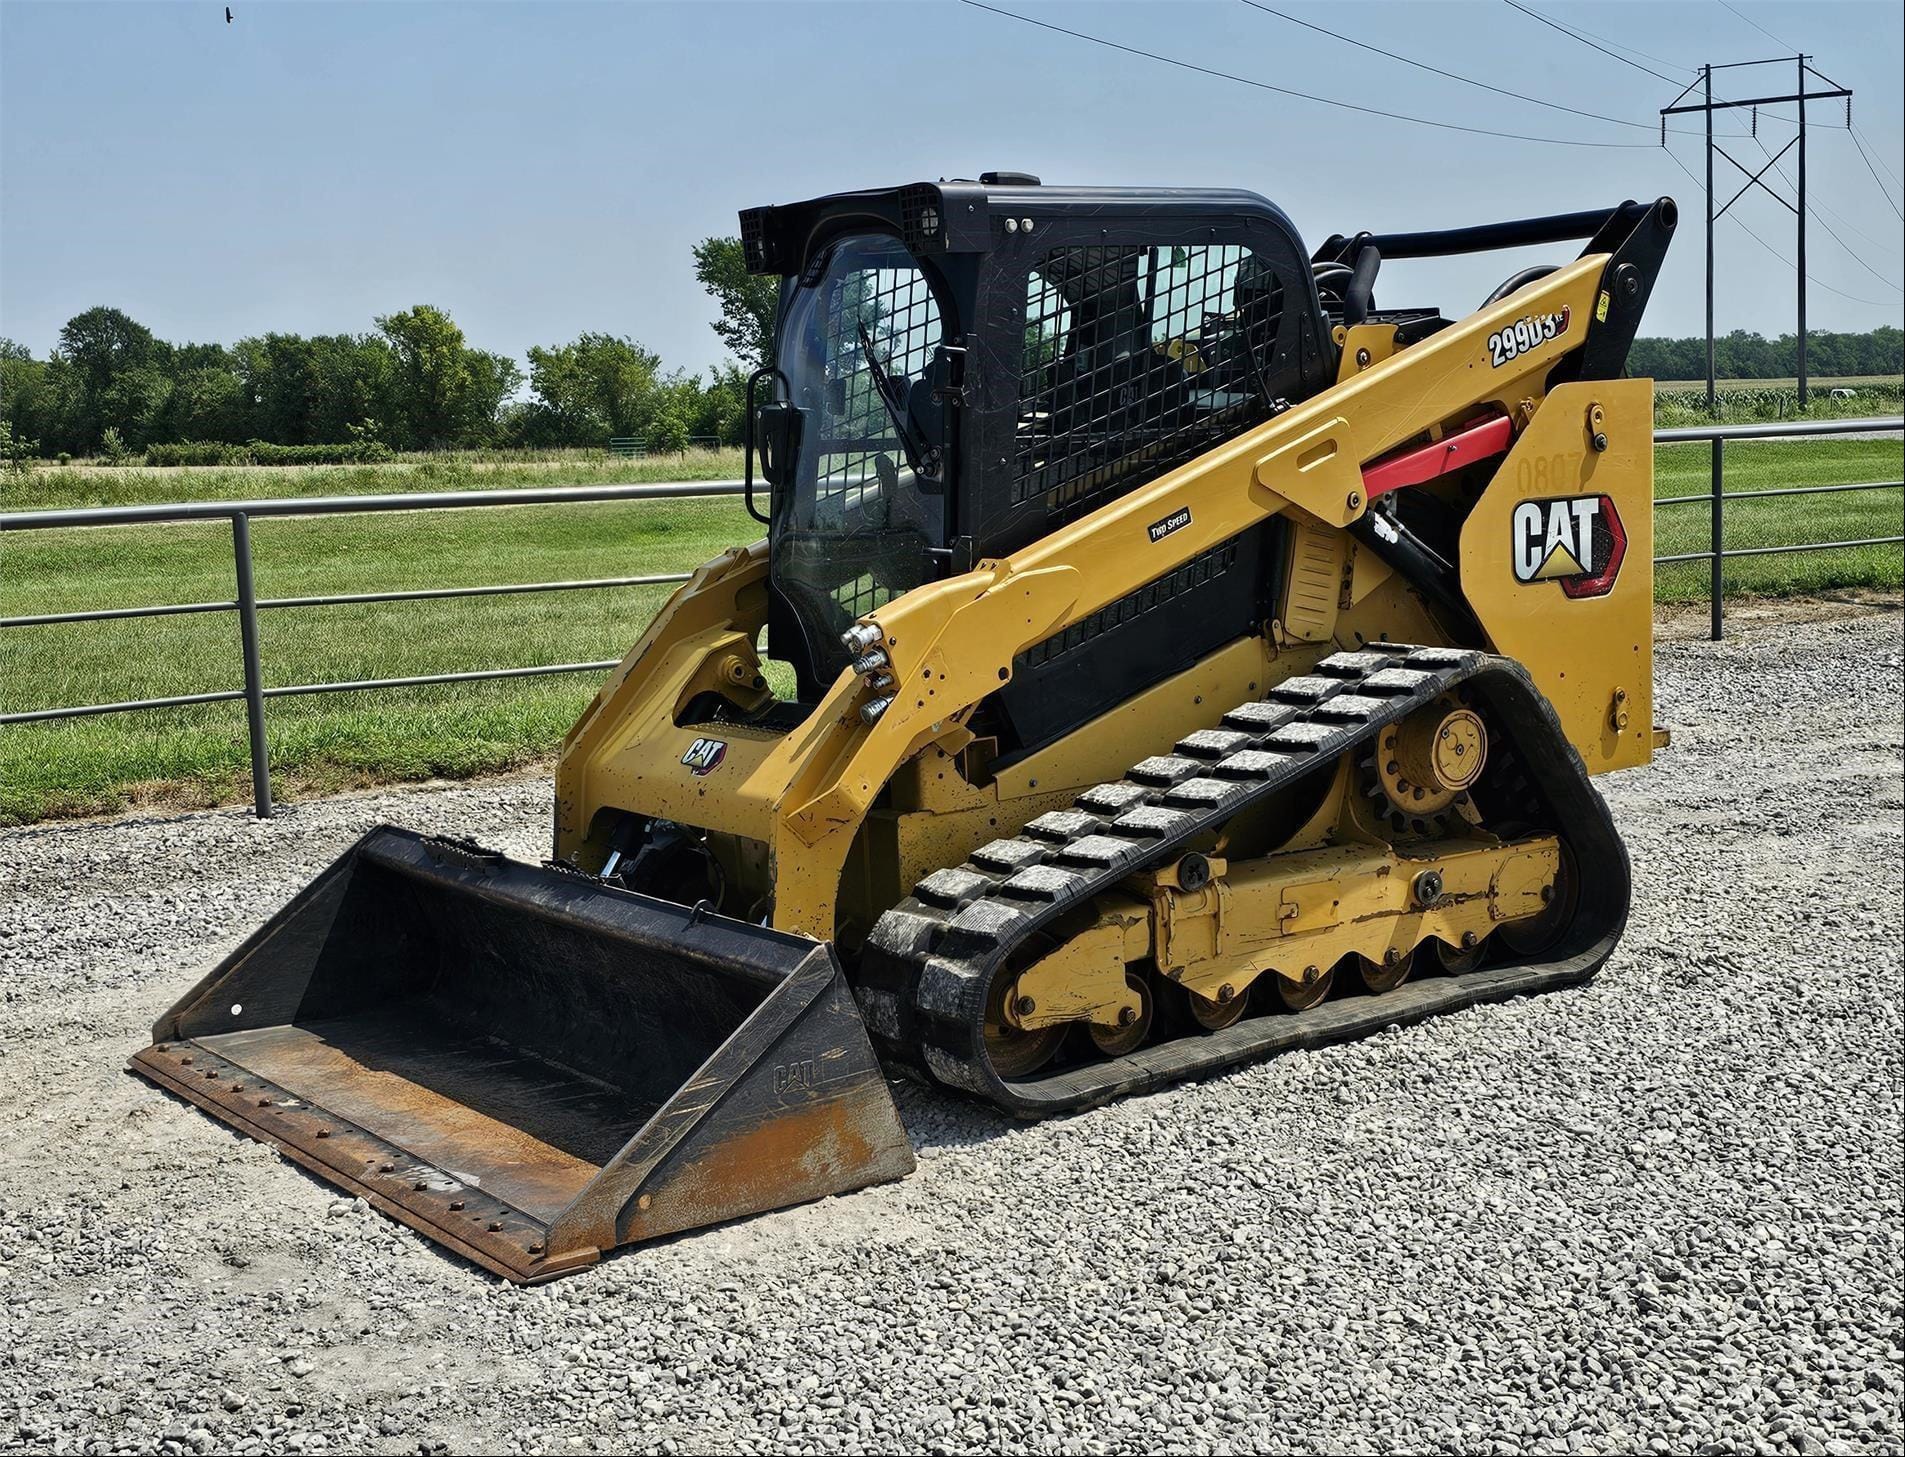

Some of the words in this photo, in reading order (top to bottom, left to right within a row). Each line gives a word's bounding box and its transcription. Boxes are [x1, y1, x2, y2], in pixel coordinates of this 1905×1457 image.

[1514, 498, 1599, 580] CAT
[682, 739, 724, 767] CAT
[773, 1060, 813, 1095] CAT
